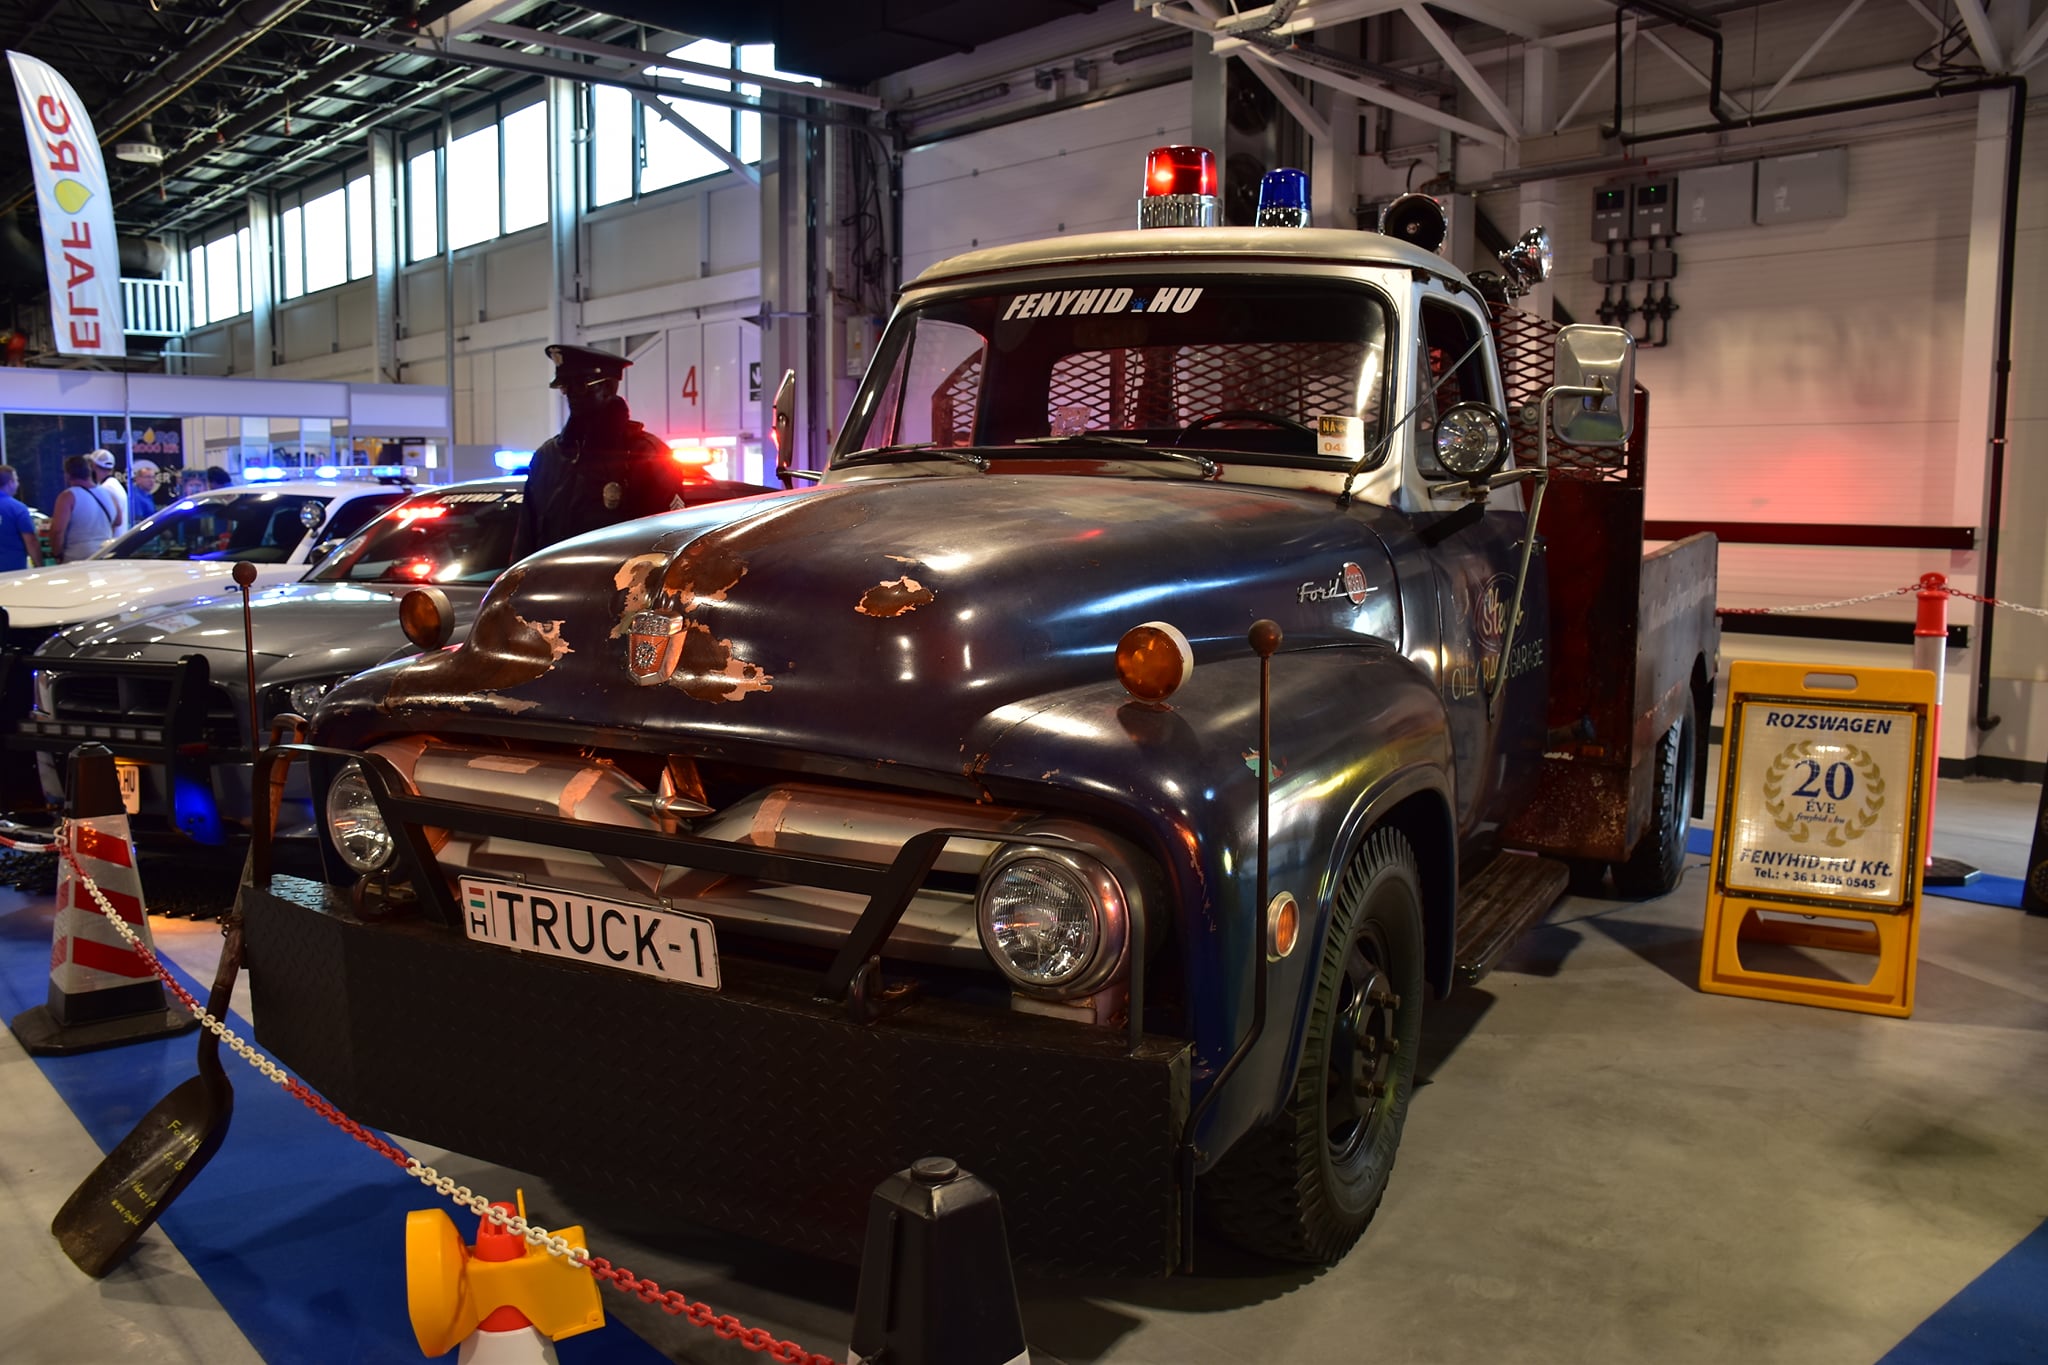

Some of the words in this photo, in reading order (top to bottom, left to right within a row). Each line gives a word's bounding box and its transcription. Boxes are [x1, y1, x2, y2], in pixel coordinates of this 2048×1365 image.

[682, 365, 698, 406] 4
[1298, 577, 1340, 602] Ford
[1766, 711, 1893, 735] ROZSWAGEN
[1791, 759, 1855, 801] 20
[1805, 799, 1836, 814] ÉVE
[1740, 848, 1856, 873] FENYHID.HU
[1860, 860, 1893, 877] Kft.
[1754, 867, 1780, 880] Tel.:
[1792, 871, 1808, 882] 36
[1846, 878, 1876, 889] 0545
[470, 911, 488, 937] H
[497, 890, 704, 979] TRUCK-1
